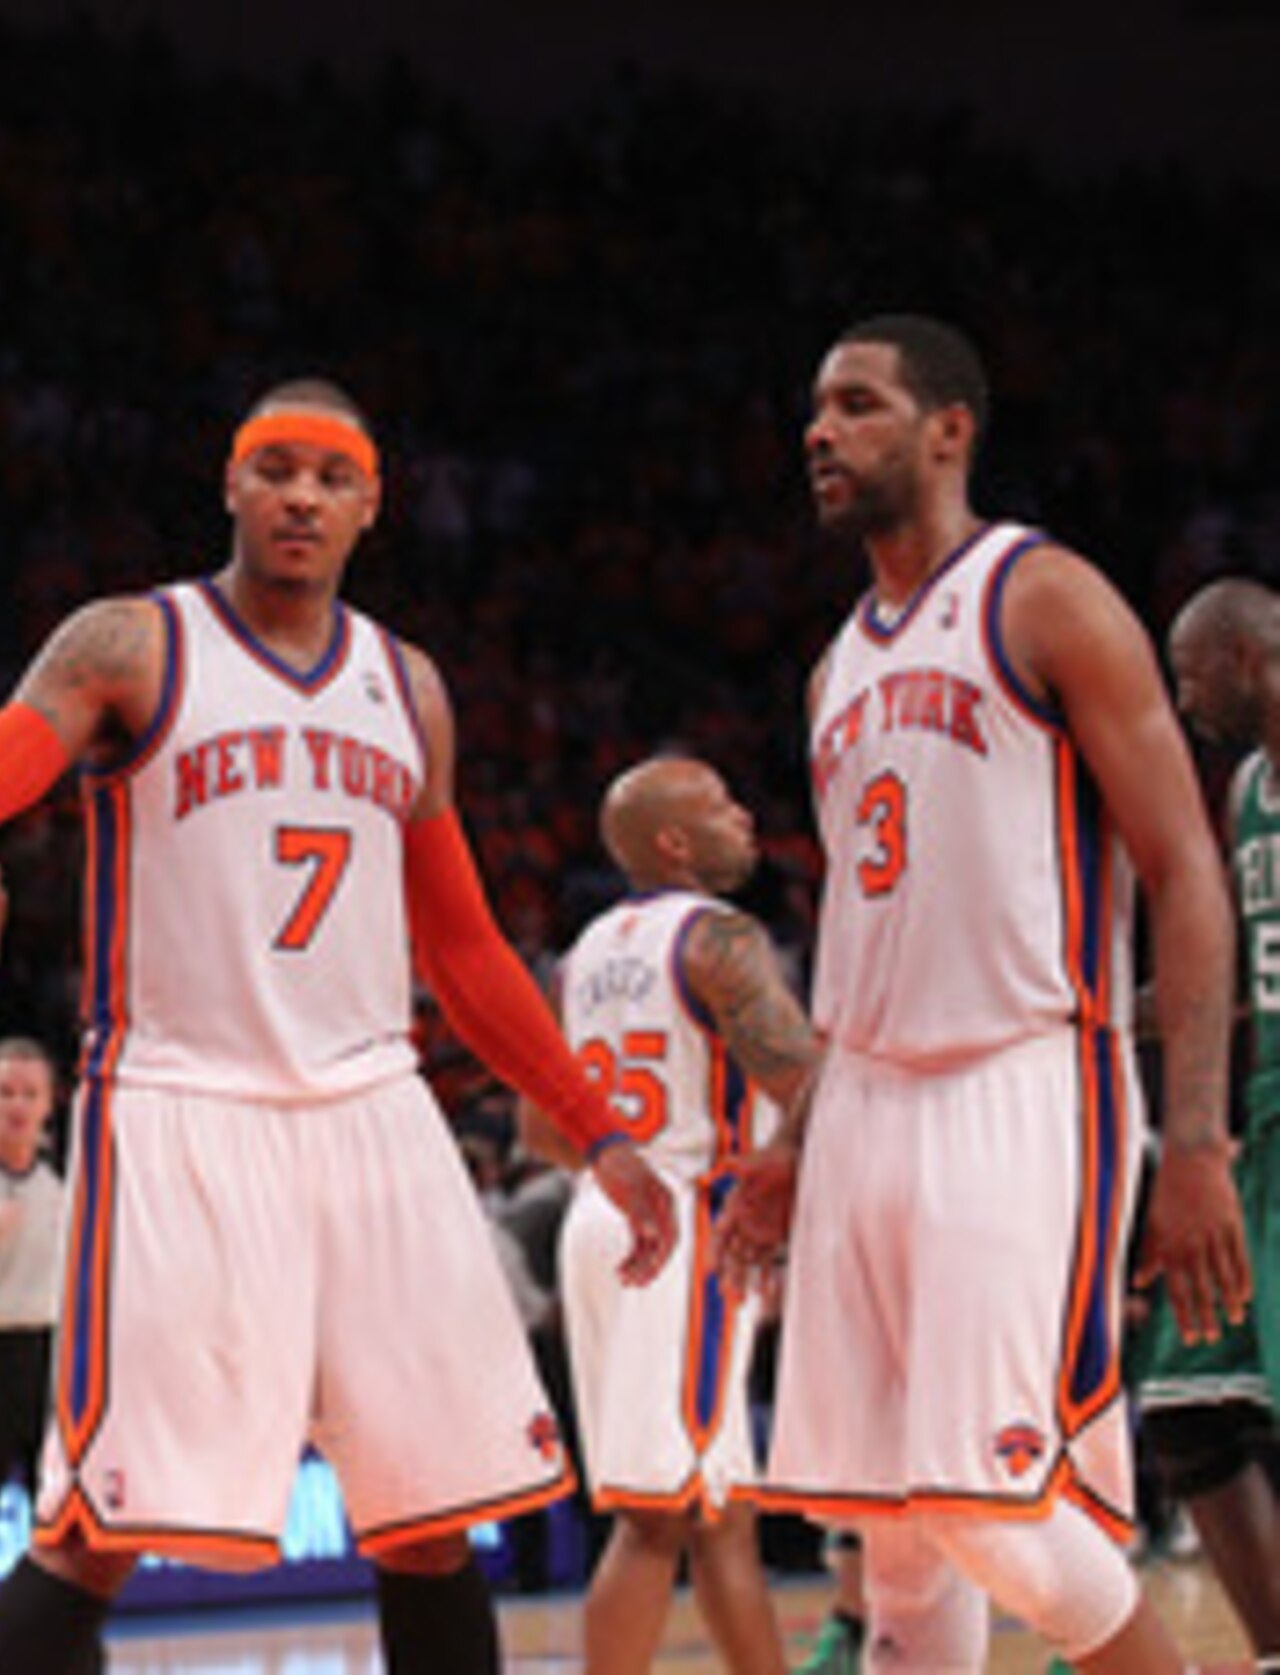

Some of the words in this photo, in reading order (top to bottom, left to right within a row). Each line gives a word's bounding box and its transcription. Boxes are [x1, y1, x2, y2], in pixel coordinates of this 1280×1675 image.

[876, 669, 989, 760] YORK
[173, 725, 286, 822] NEW
[271, 823, 353, 953] 7
[856, 769, 908, 899] 3
